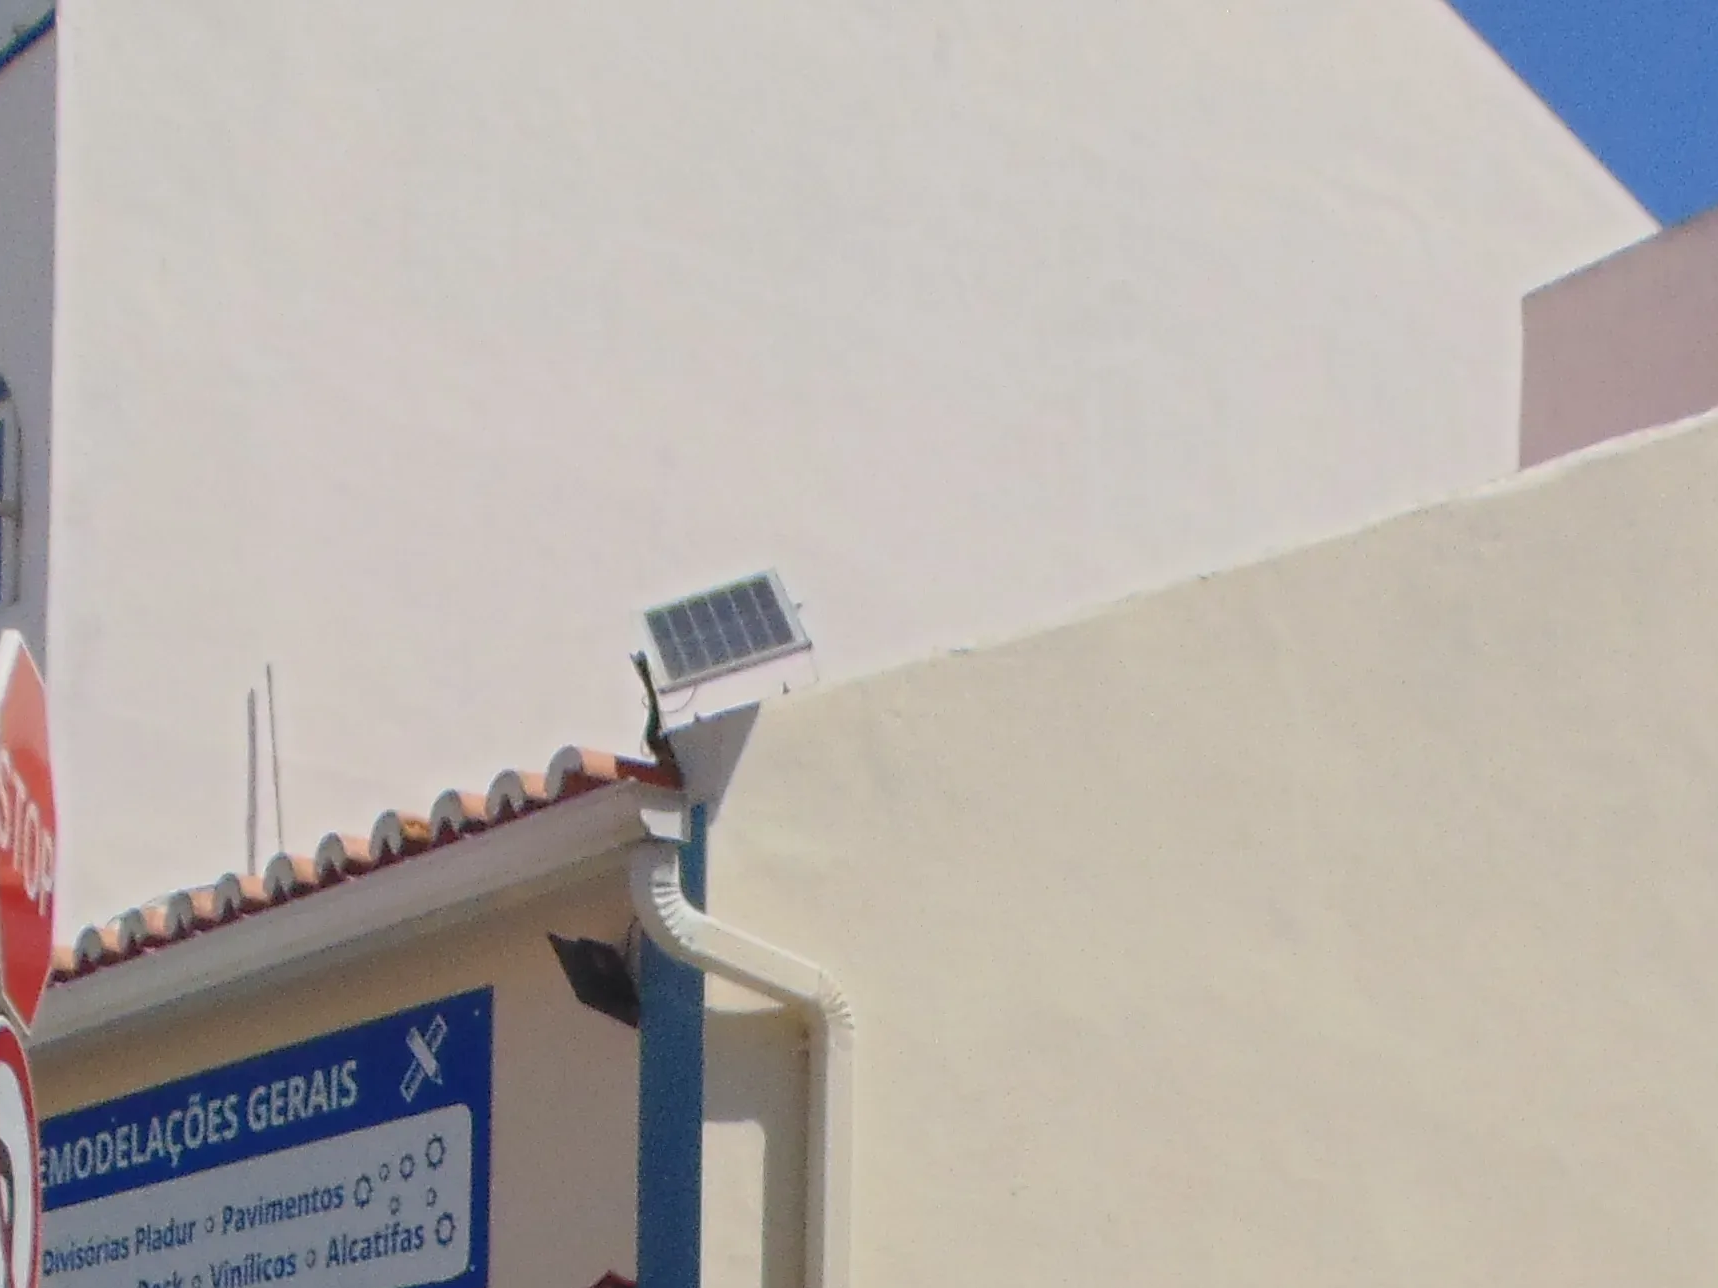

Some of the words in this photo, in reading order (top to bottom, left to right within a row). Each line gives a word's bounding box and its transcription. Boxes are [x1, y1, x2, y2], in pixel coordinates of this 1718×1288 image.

[40, 1093, 239, 1188] EMODELAÇÕES
[246, 1059, 358, 1133] GERAIS
[42, 1233, 130, 1277] Divisórias
[135, 1217, 197, 1255] Pladur
[221, 1183, 344, 1235] Pavimentos
[326, 1220, 425, 1269] Alcatifas
